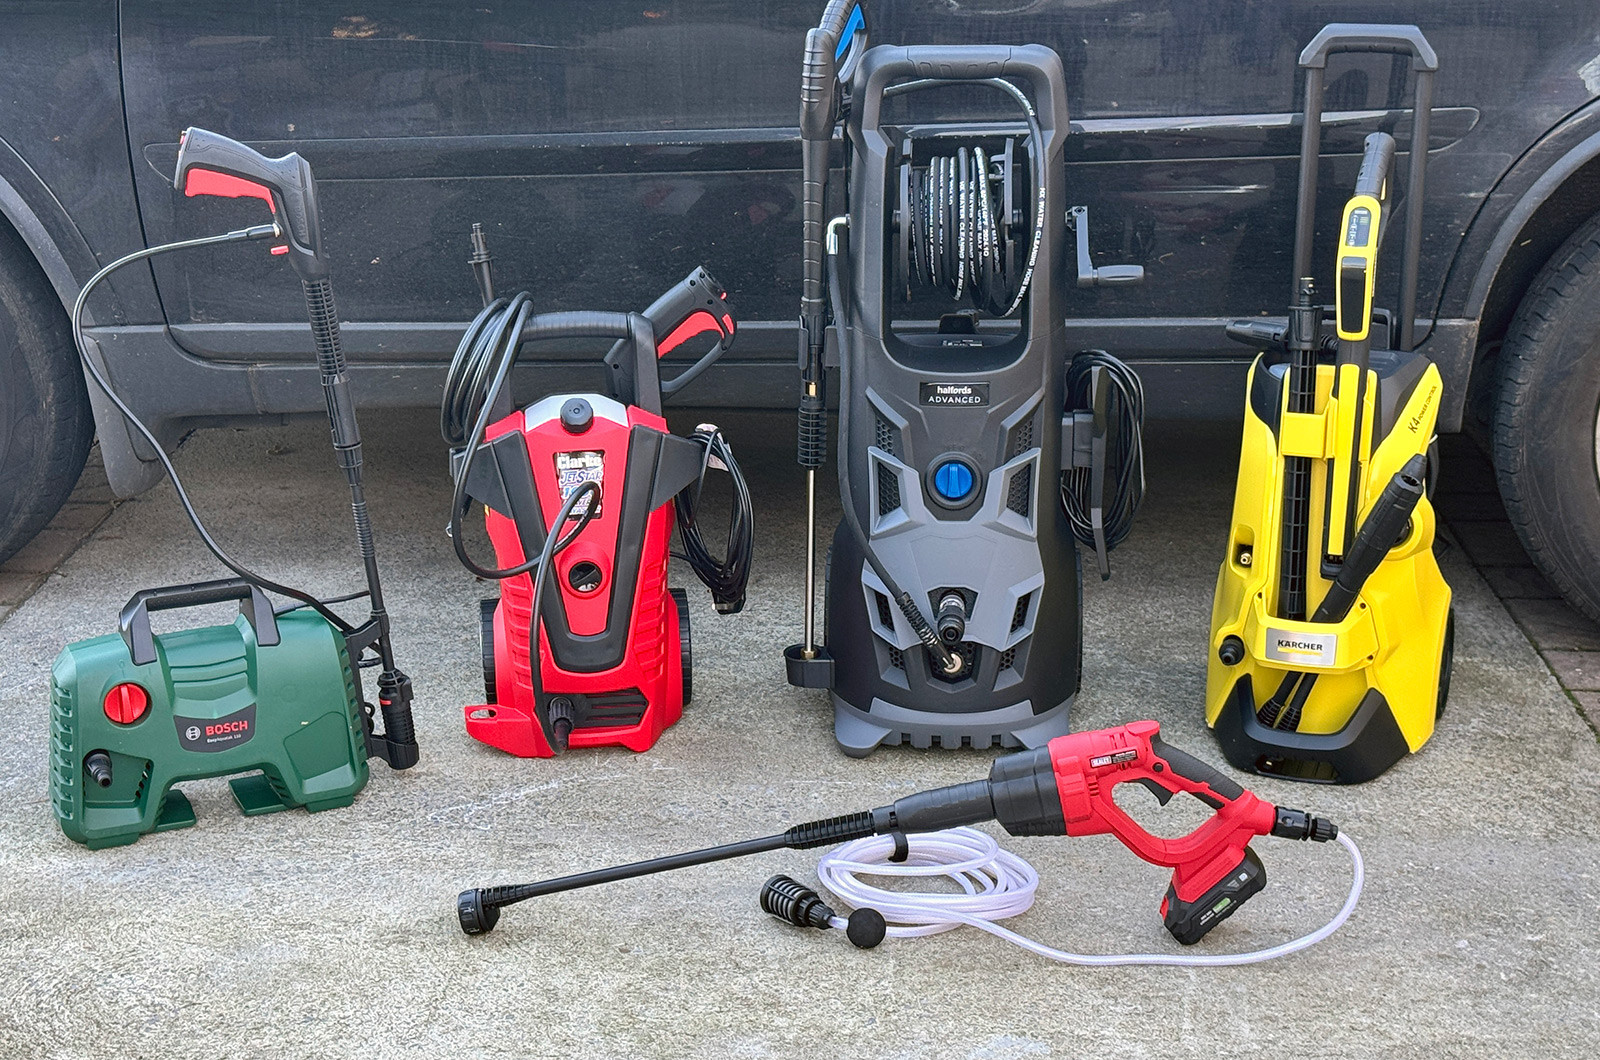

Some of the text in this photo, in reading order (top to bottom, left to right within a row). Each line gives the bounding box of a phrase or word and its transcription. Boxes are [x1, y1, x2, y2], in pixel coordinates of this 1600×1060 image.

[1036, 201, 1045, 228] WATER
[1029, 230, 1042, 266] CLEANING
[937, 386, 972, 394] halfords
[928, 396, 981, 404] ADVANCED
[1408, 416, 1420, 434] K4
[557, 455, 603, 470] Clarke
[205, 720, 248, 736] BOSCH
